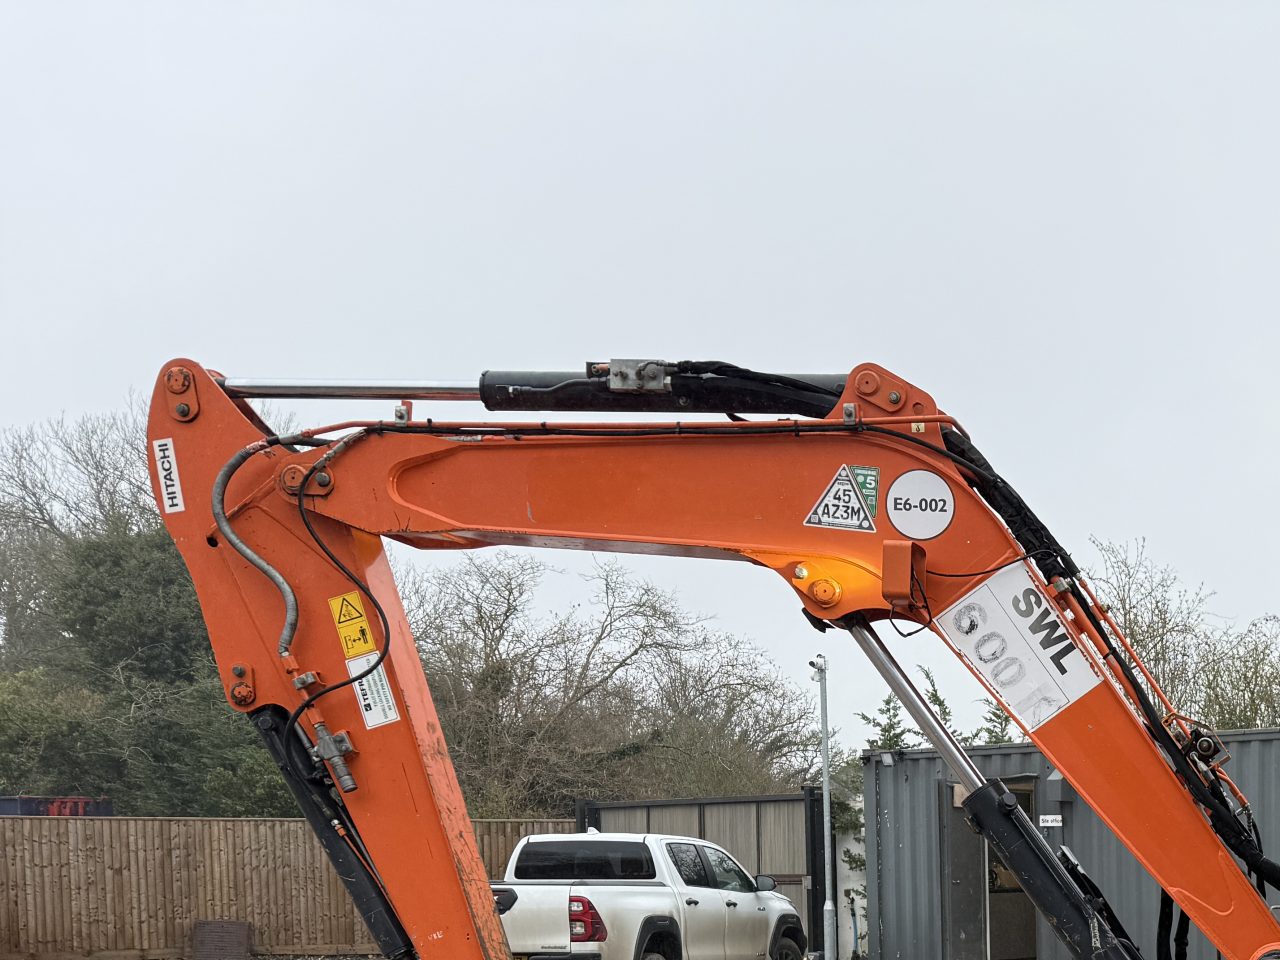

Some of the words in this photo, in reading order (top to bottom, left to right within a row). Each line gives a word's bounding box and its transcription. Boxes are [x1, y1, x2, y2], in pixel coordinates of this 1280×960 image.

[158, 443, 178, 508] HITACHI
[865, 476, 876, 488] 5
[833, 488, 852, 504] 45
[893, 497, 947, 512] E6-002
[821, 503, 861, 522] AZ3M
[1012, 587, 1076, 676] SWL
[358, 678, 369, 702] TEFR
